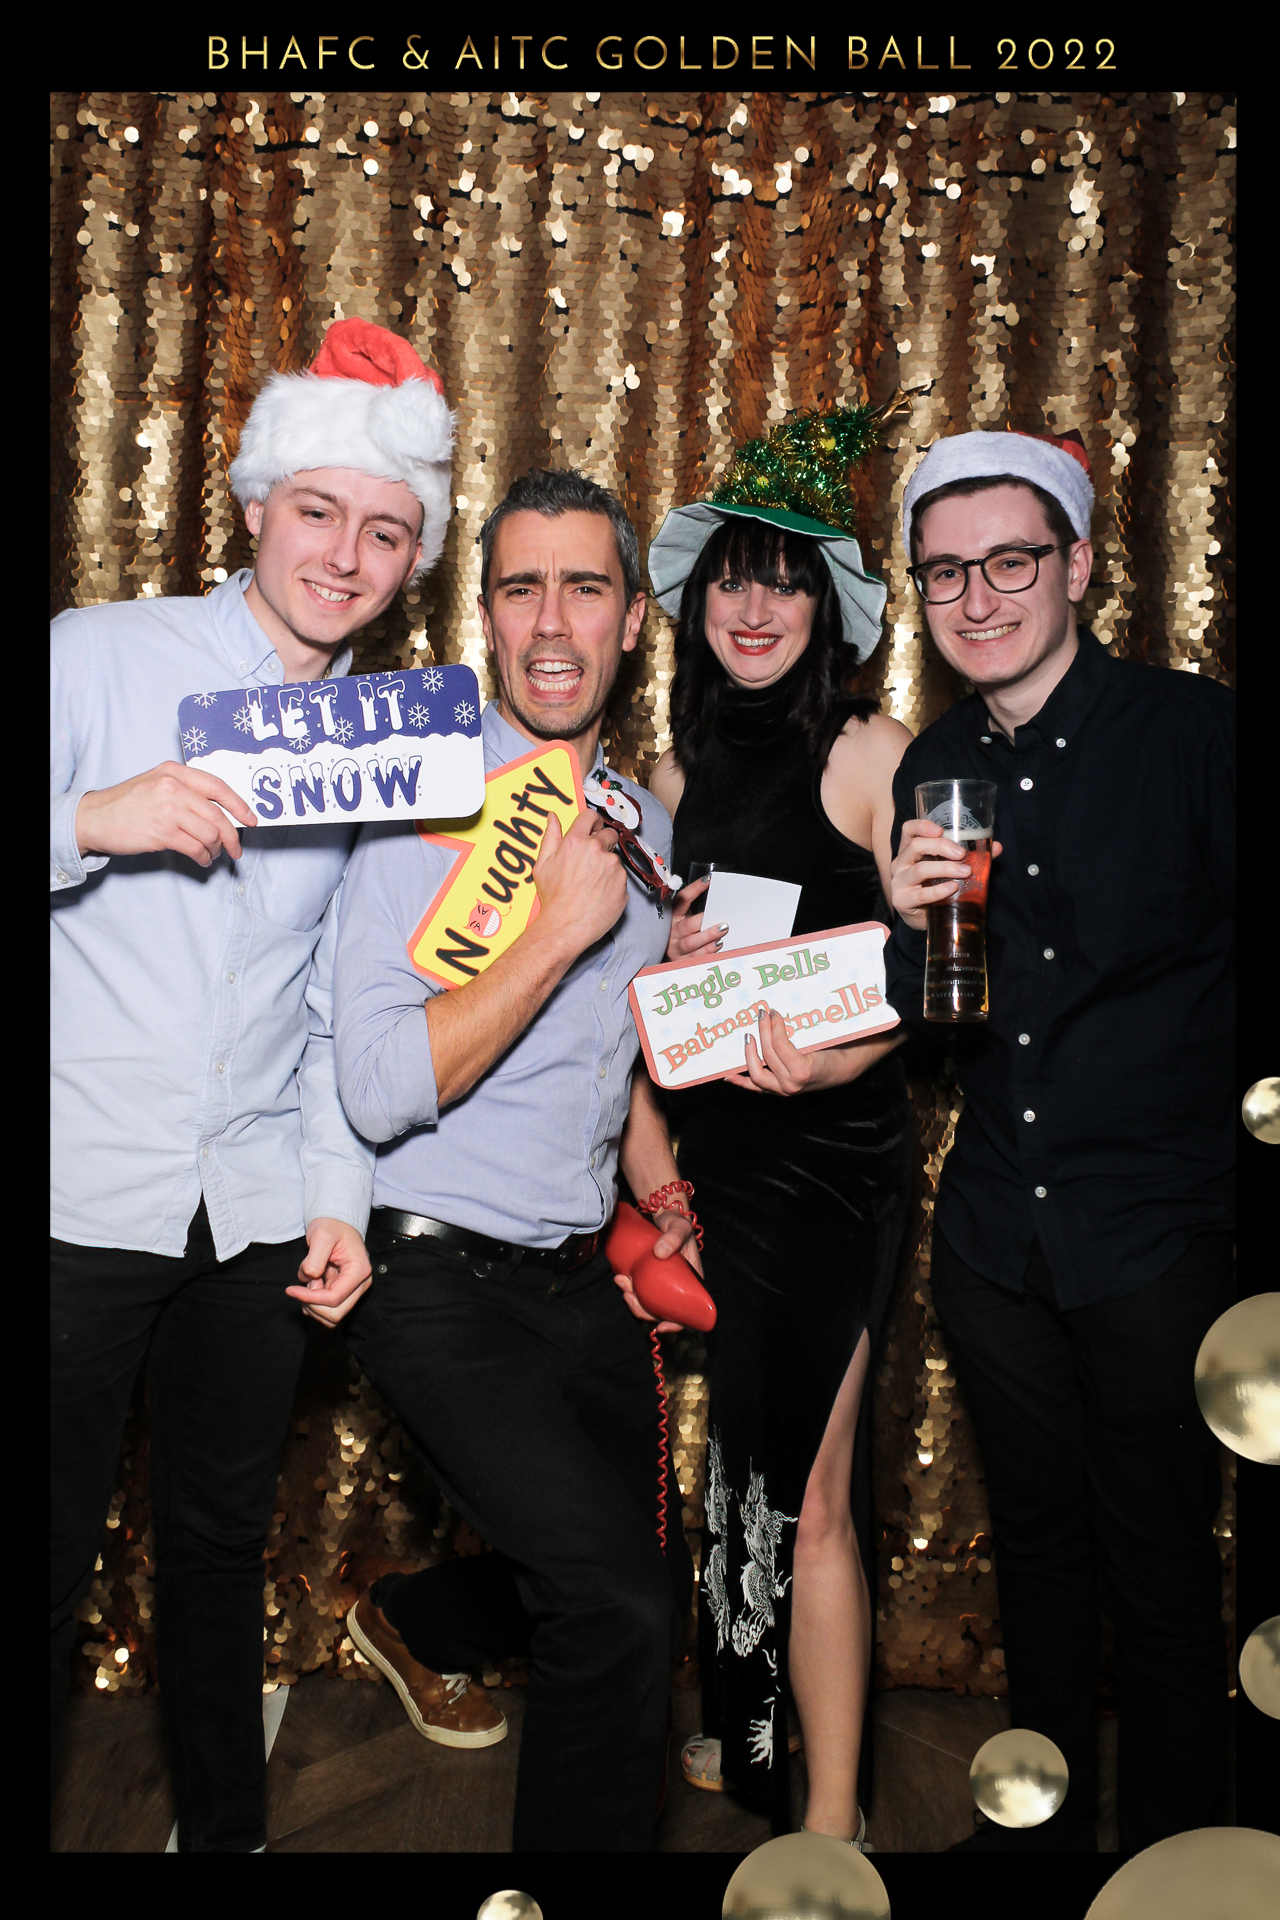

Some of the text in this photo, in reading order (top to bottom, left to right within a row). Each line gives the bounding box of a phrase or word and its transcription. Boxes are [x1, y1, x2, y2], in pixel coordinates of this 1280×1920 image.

[246, 679, 406, 742] LET IT
[251, 755, 423, 820] SNOW
[652, 948, 831, 1016] Jingle Bells
[657, 999, 771, 1075] Batman
